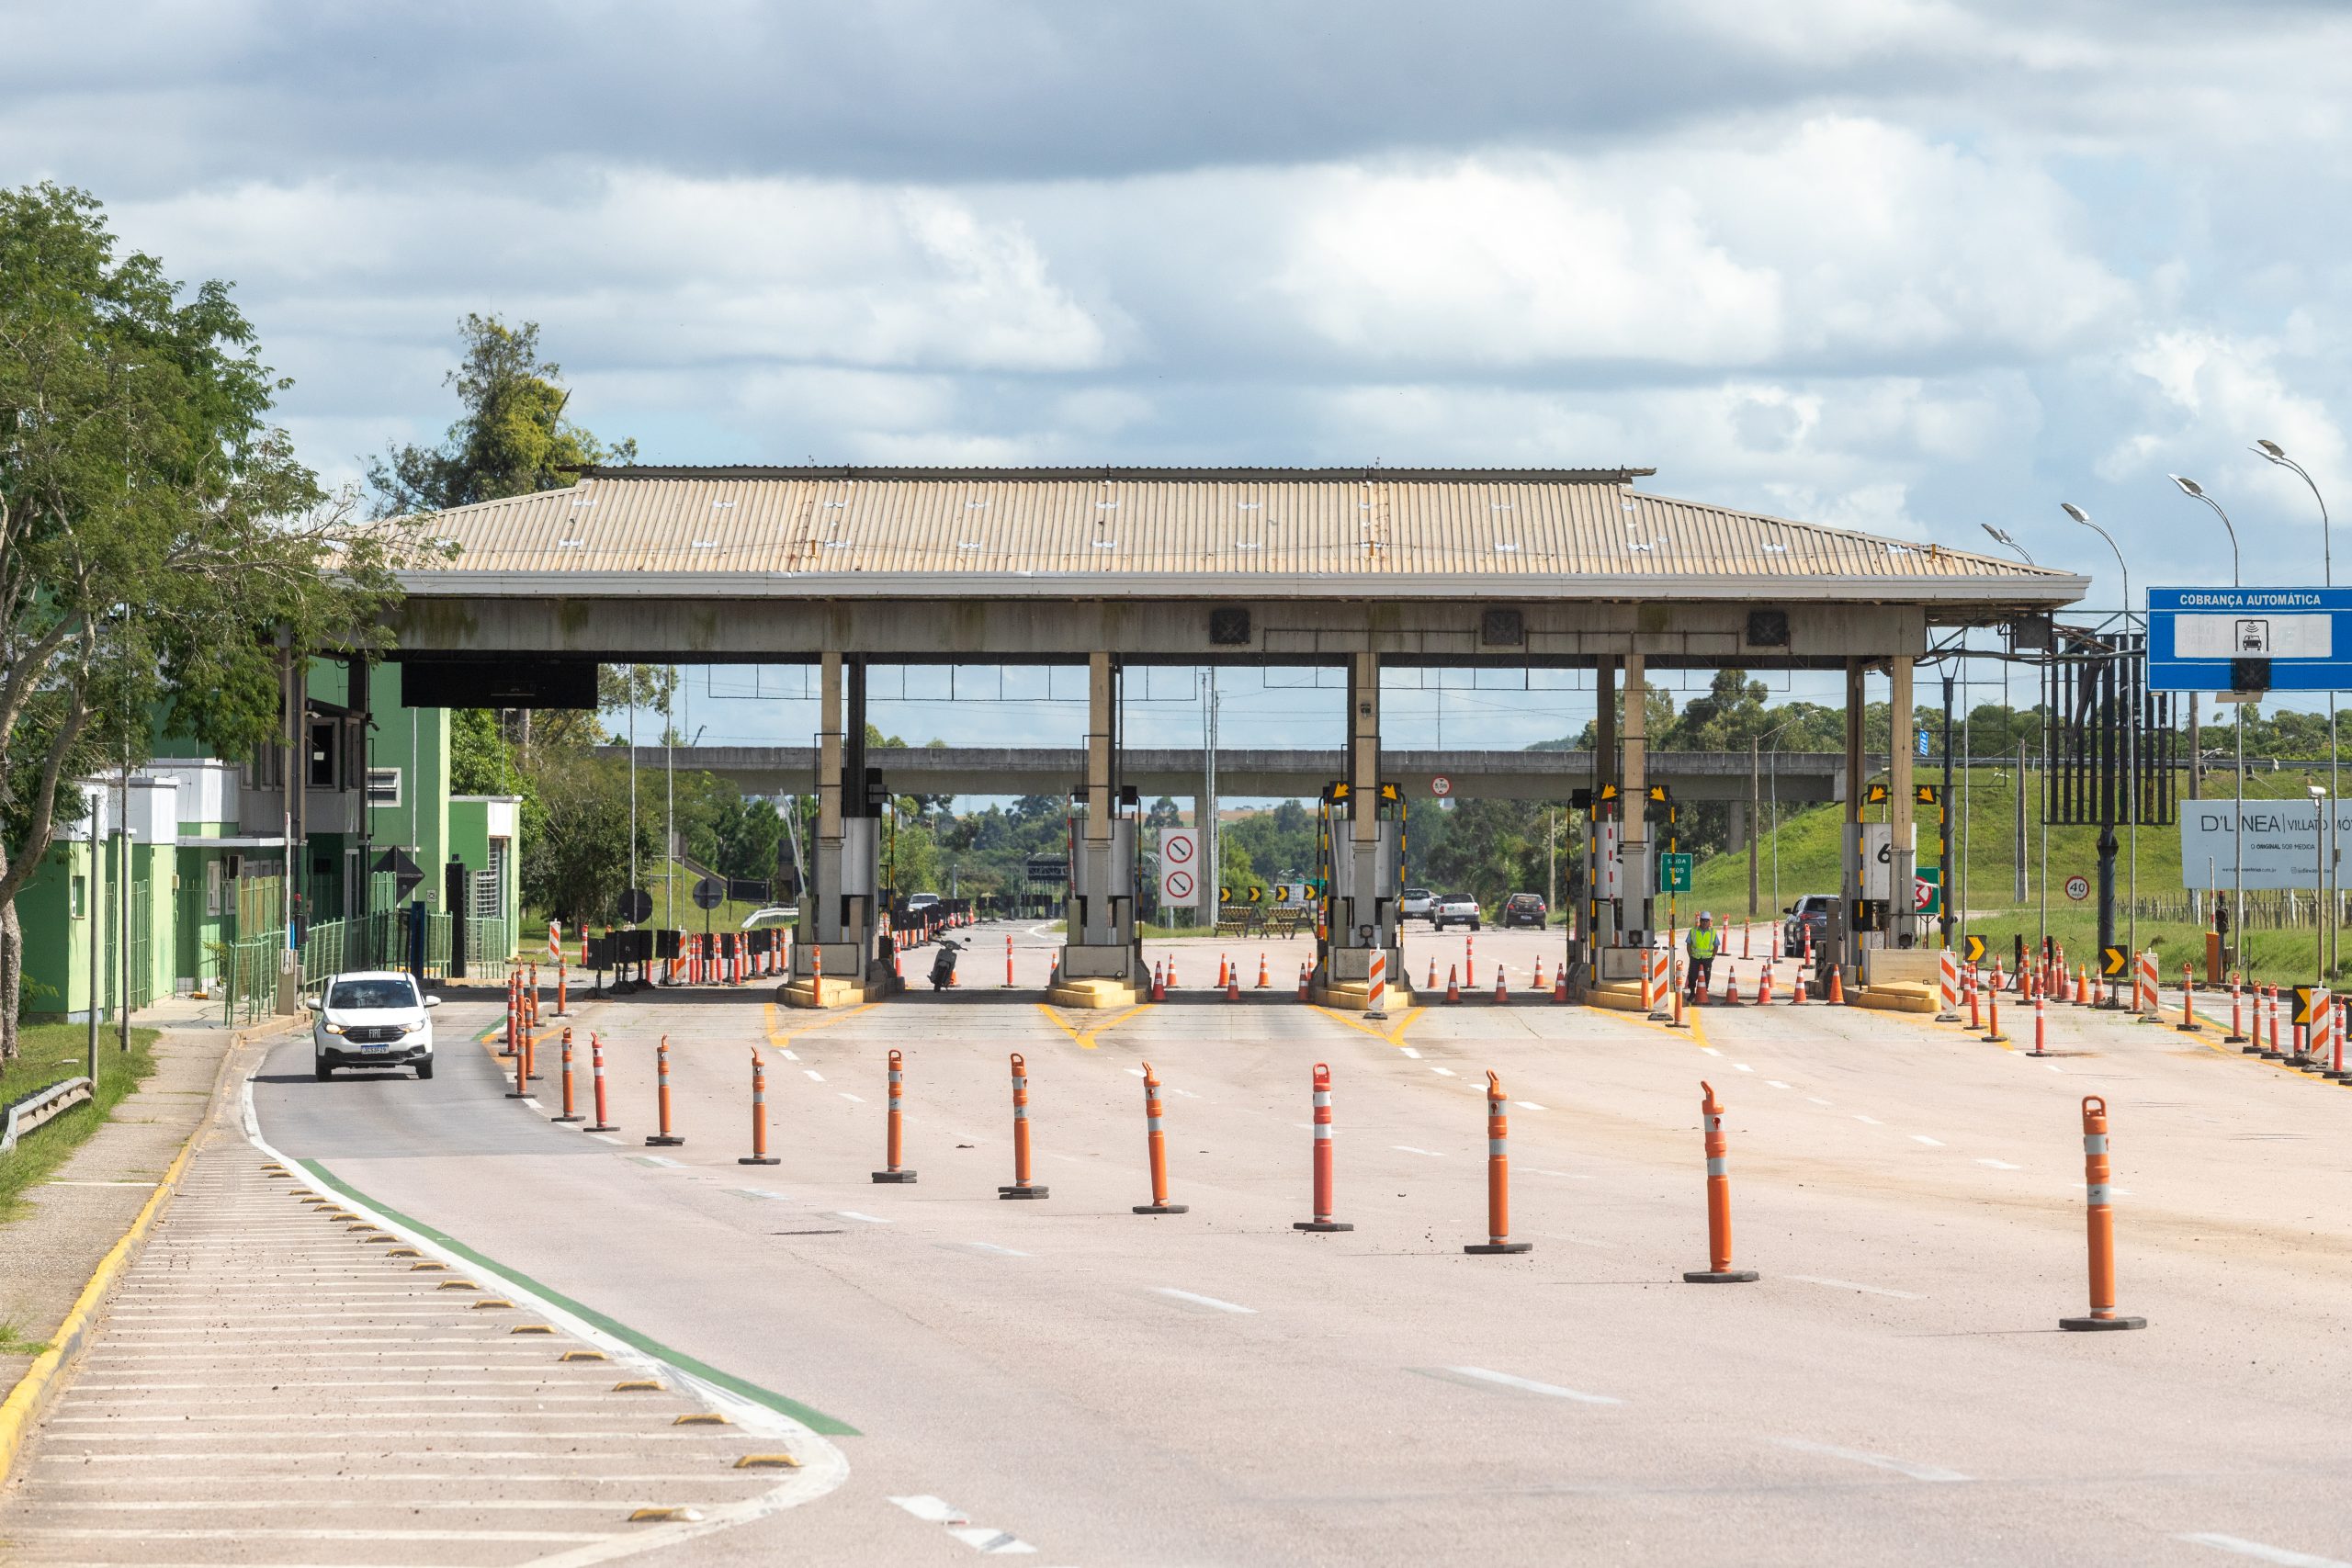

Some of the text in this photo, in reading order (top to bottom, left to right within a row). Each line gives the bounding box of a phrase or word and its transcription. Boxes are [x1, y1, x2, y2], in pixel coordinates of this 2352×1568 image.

[2179, 592, 2322, 608] COBRANÇA AUTOMÁTICA
[2201, 815, 2280, 832] D'LNEA
[1877, 843, 1891, 864] 6
[2070, 883, 2086, 892] 40
[369, 1029, 380, 1038] FIAT
